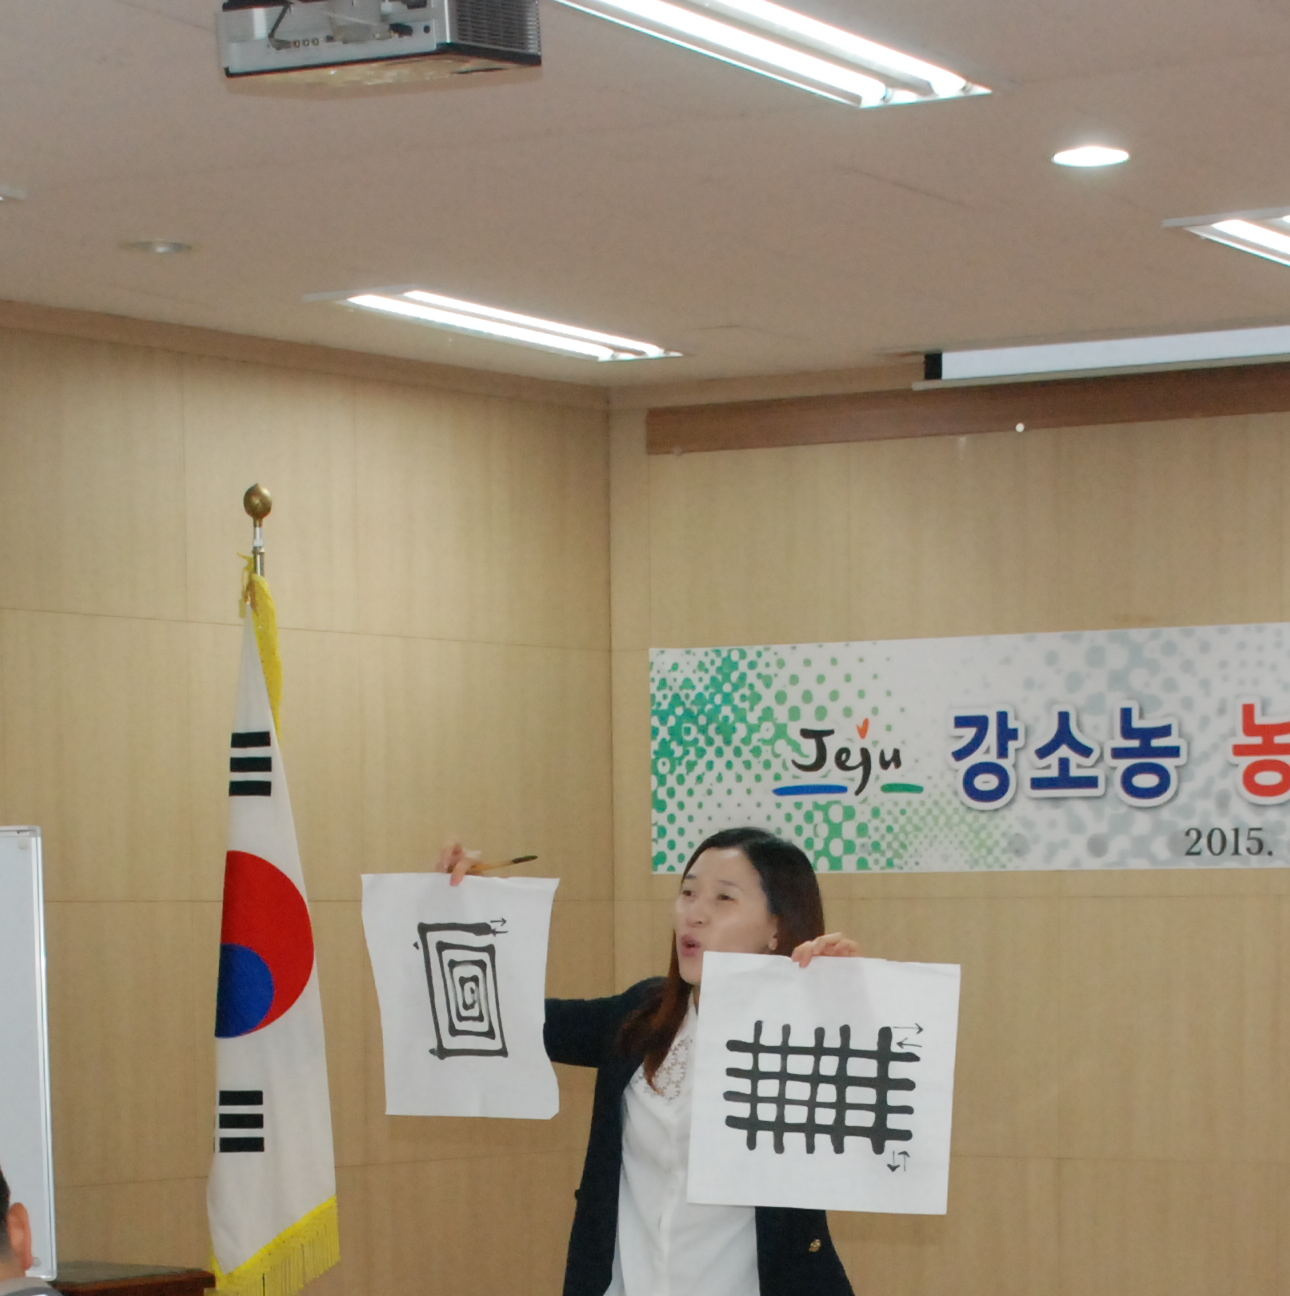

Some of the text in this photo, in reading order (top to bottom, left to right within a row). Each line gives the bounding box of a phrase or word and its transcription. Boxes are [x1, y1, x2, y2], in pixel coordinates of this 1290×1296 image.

[791, 718, 903, 797] Jeju
[952, 706, 1182, 804] 강소농
[1184, 827, 1273, 858] 2015.
